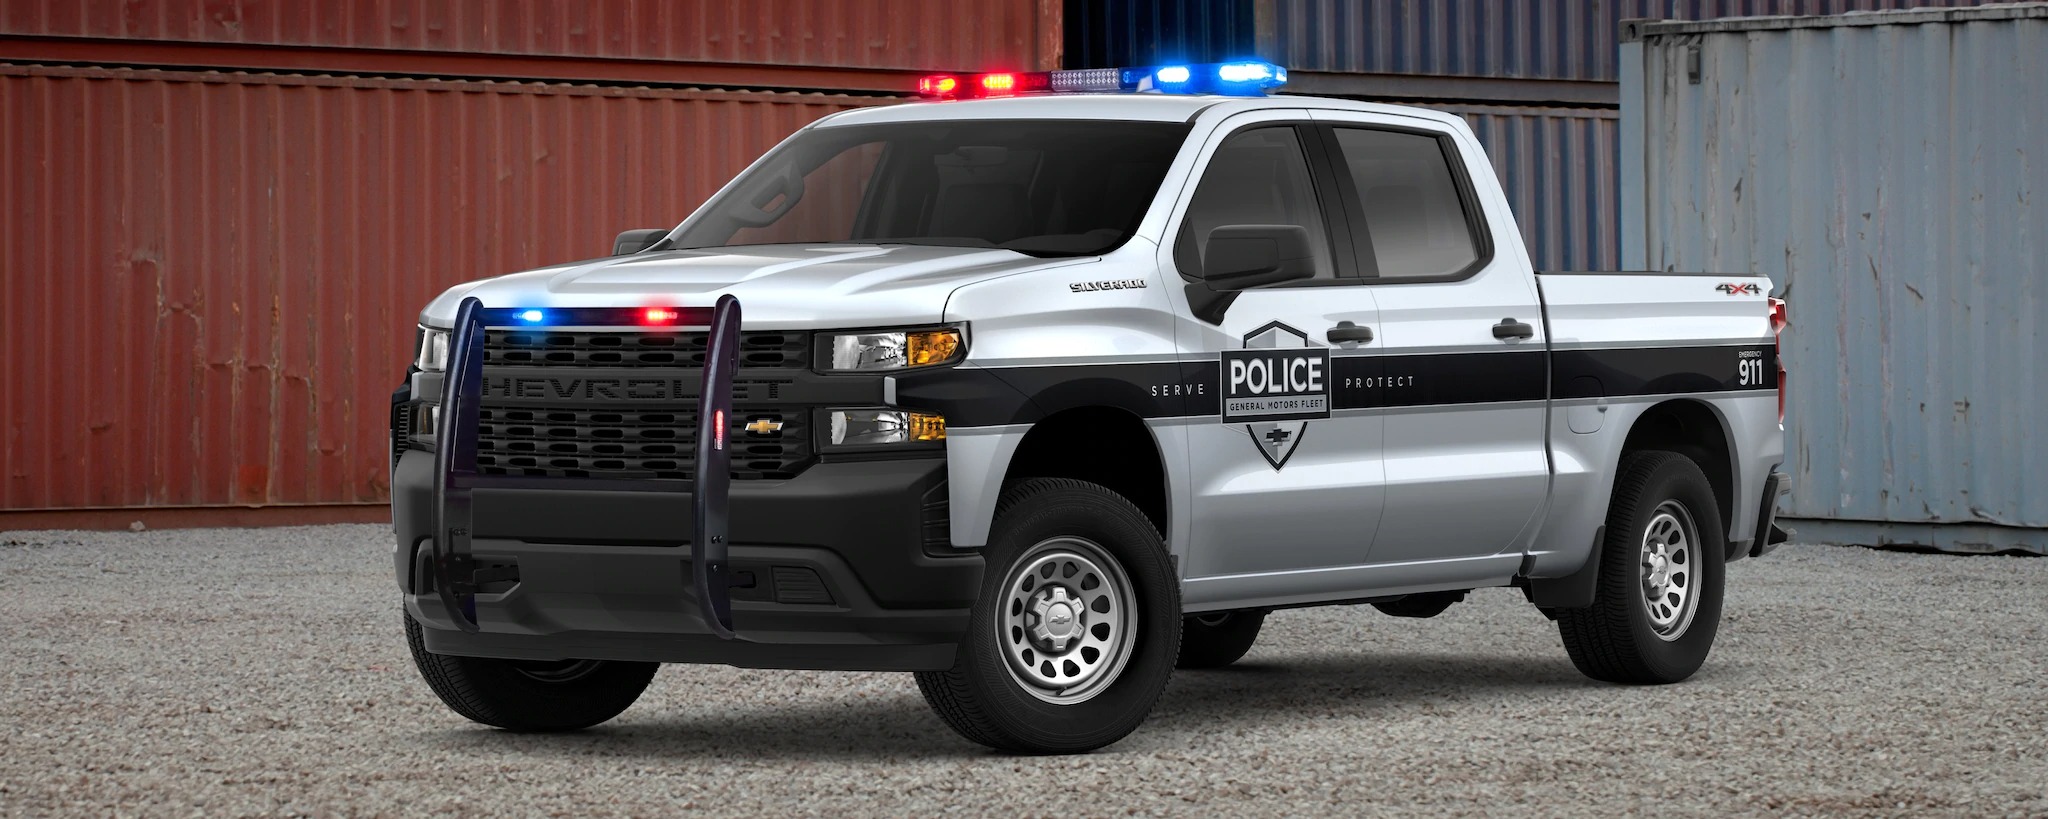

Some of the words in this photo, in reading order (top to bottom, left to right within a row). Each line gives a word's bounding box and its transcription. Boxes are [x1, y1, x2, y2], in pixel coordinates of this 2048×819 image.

[1069, 279, 1147, 293] SILVERADO
[1230, 356, 1324, 395] POLICE
[1738, 359, 1763, 386] 911
[482, 377, 794, 399] HEVROLET
[1345, 376, 1413, 389] PROTECT
[1151, 383, 1204, 397] SERVE
[1229, 402, 1265, 411] GENERAL
[1267, 400, 1299, 410] MOTORS
[1301, 399, 1323, 408] FLEET
